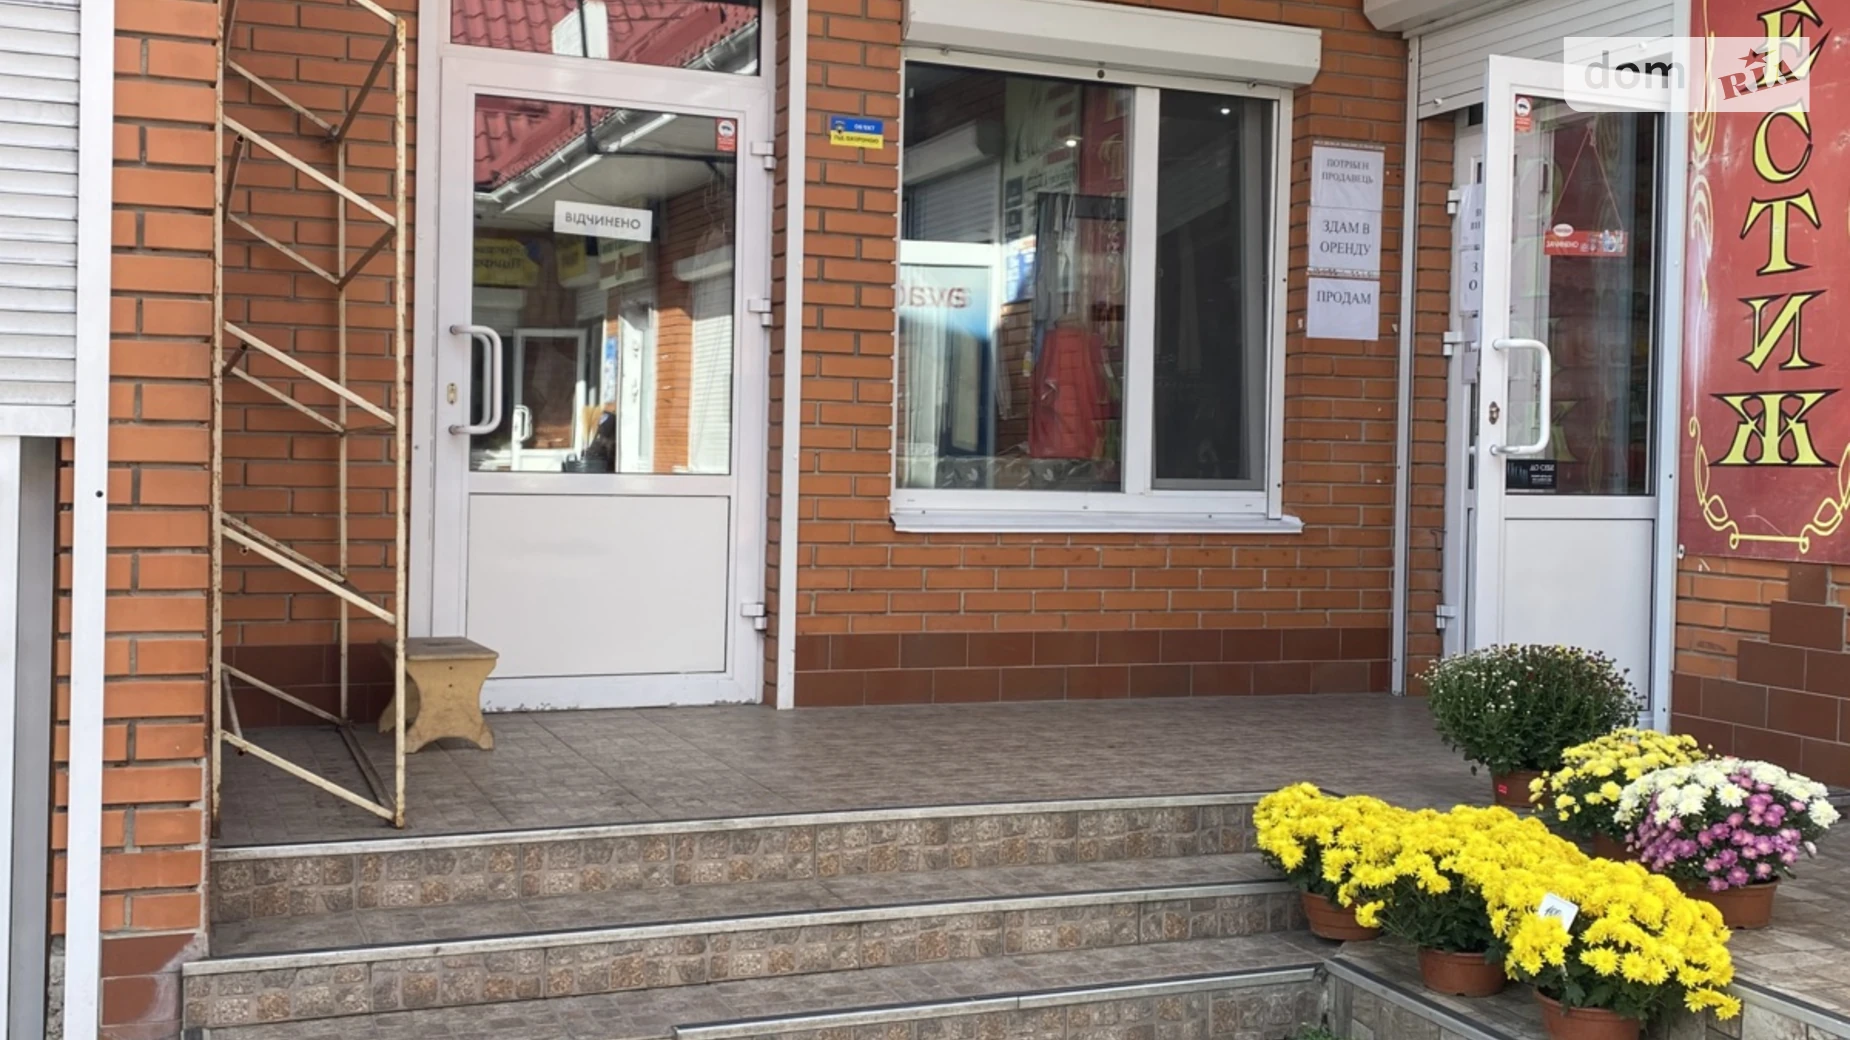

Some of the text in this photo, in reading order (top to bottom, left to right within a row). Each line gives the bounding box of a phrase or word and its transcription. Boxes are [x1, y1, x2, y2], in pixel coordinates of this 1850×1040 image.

[1326, 158, 1370, 170] ПОТРІБЕН
[1322, 171, 1375, 185] ПРОДАВЕЦЬ
[565, 211, 641, 230] ВІДЧИНЕНО
[1322, 220, 1370, 235] ЗДАМ В
[1319, 240, 1371, 256] ОРЕНДУ
[1316, 290, 1371, 305] ПРОДАМ
